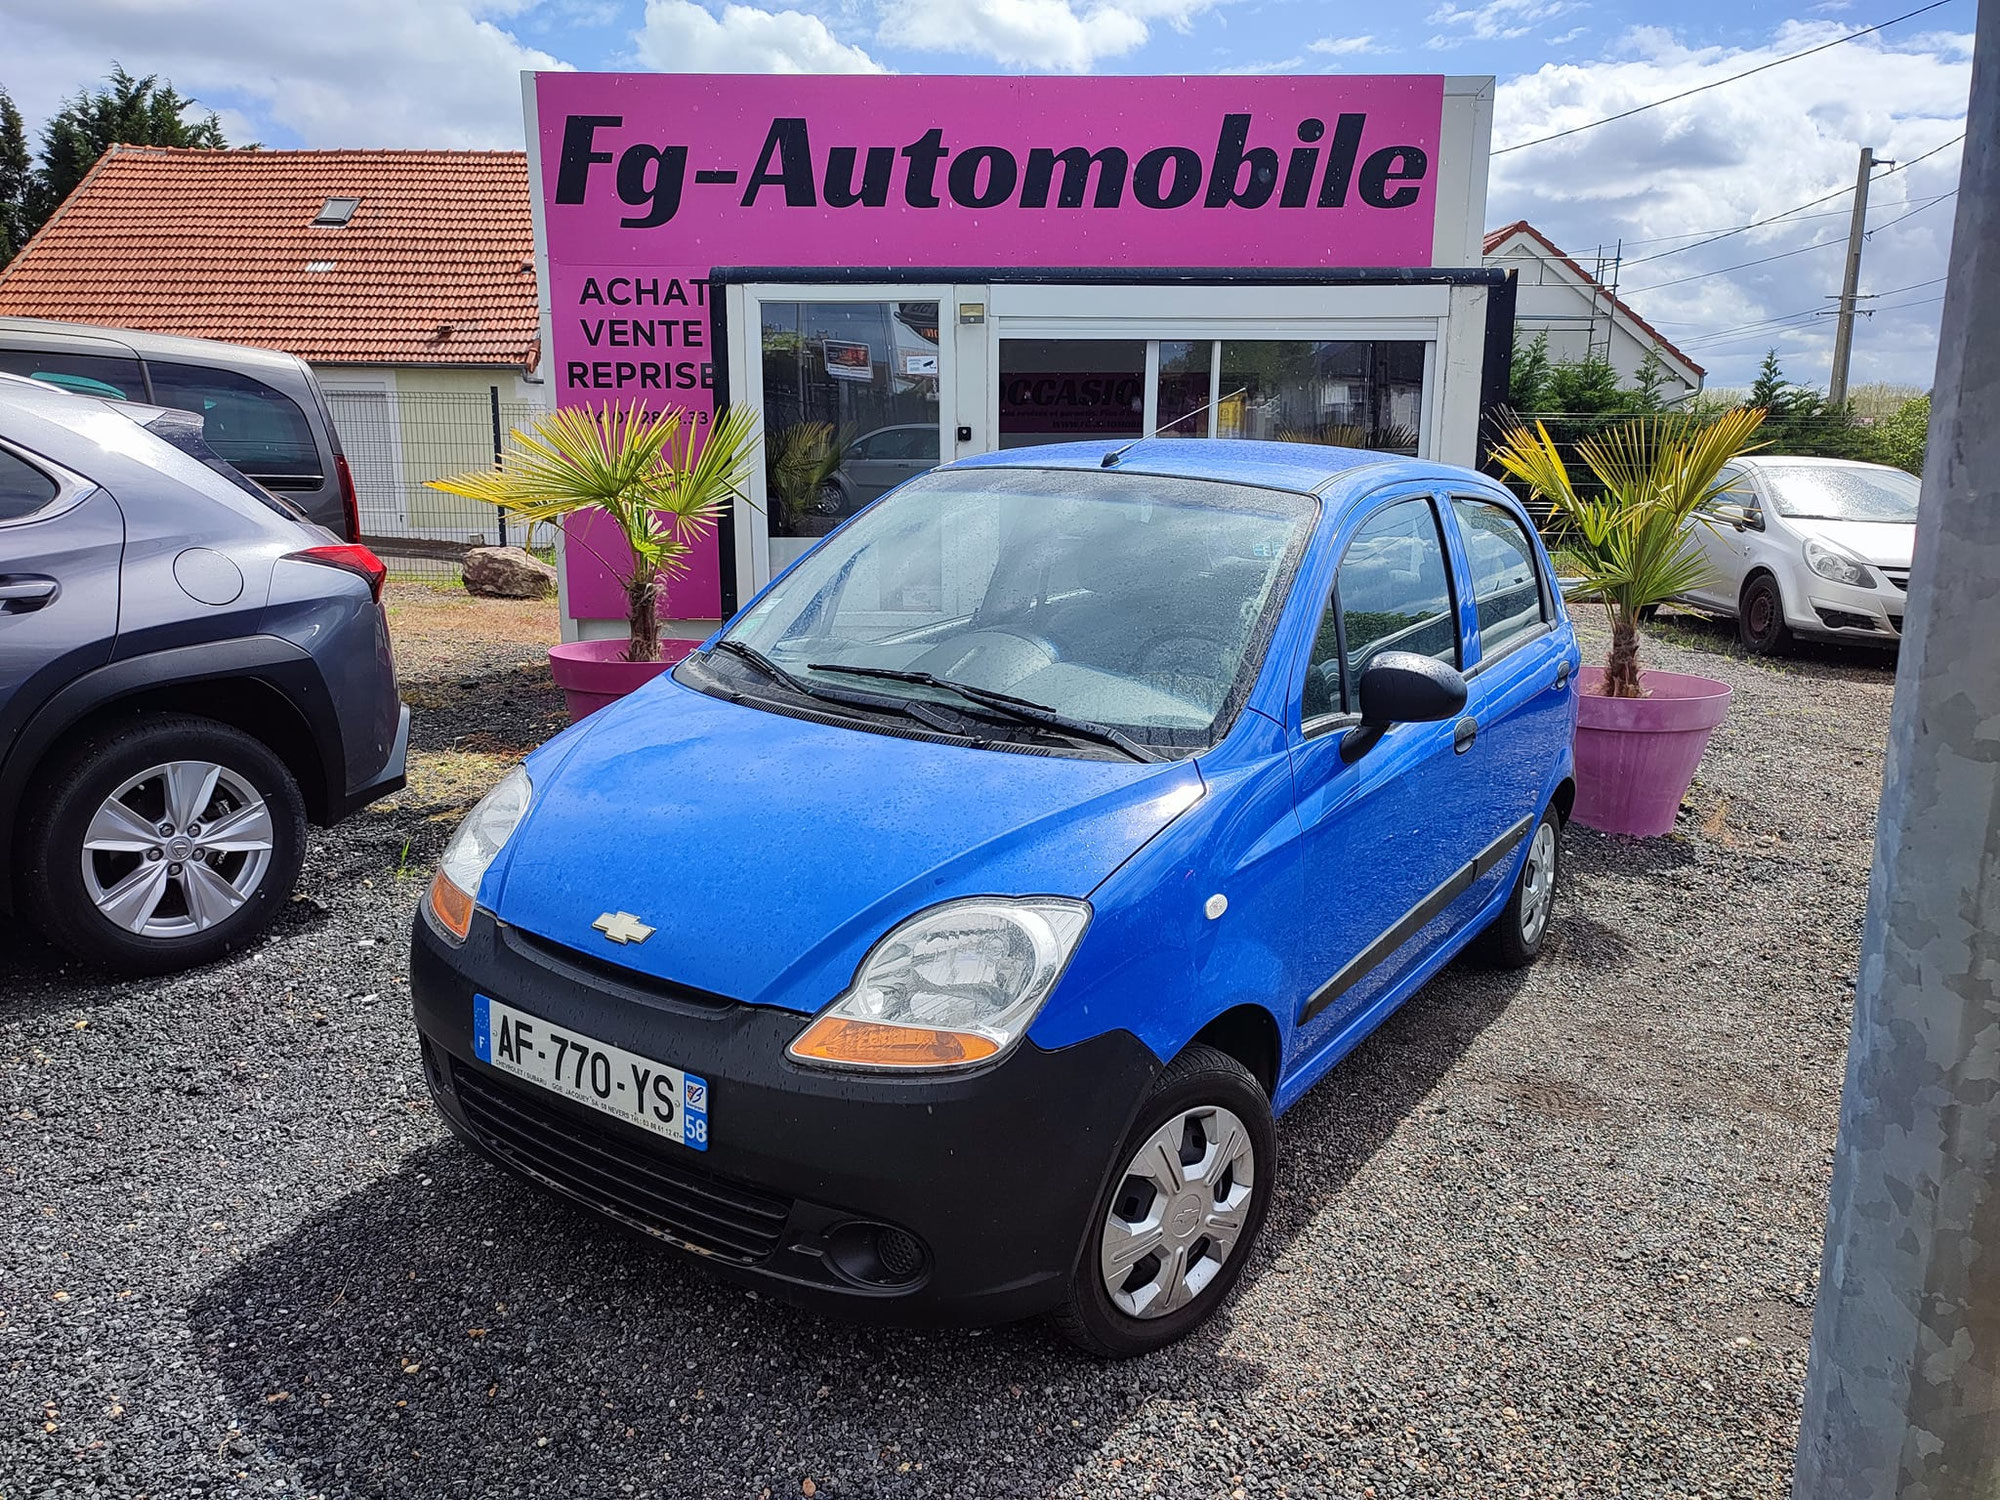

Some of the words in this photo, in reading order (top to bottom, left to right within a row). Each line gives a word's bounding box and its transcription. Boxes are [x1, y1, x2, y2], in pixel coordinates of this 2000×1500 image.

[554, 112, 1428, 229] Fg-Automobile
[579, 277, 711, 307] ACHAT
[579, 319, 704, 347] VENTE
[567, 361, 715, 390] REPRISE
[478, 1036, 485, 1048] F
[498, 1015, 675, 1124] AF-770-YS
[608, 1105, 630, 1120] NEVERS
[685, 1114, 708, 1144] 58
